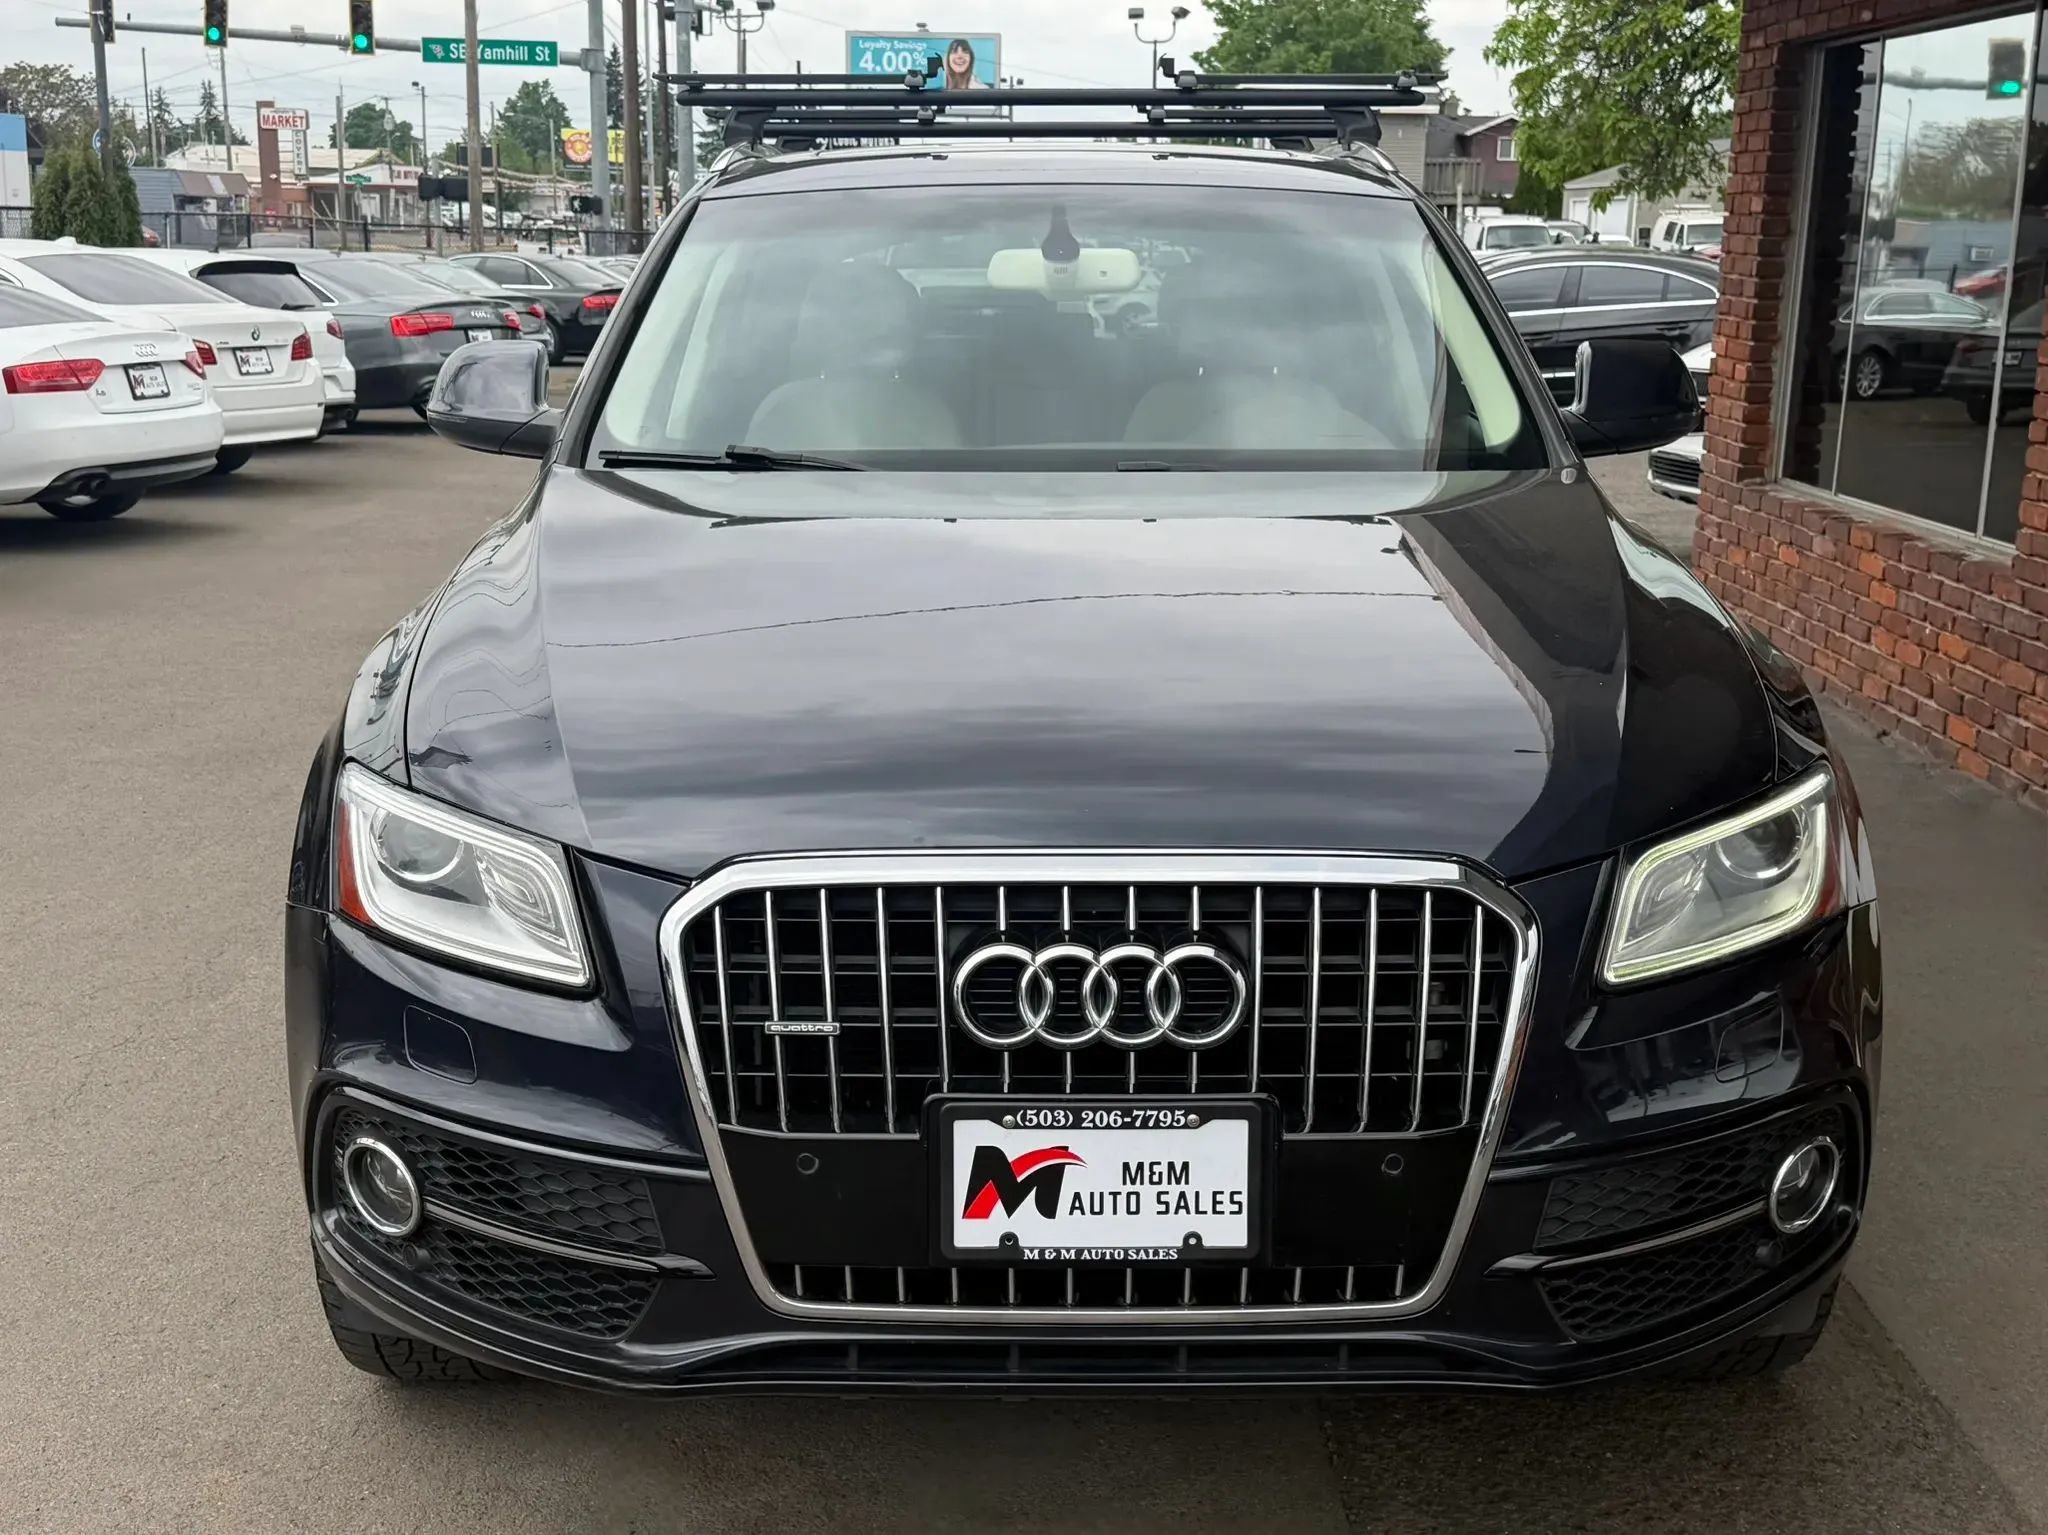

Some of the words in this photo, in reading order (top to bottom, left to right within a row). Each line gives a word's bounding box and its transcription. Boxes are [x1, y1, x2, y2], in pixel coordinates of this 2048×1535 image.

[449, 43, 466, 59] SE
[535, 46, 550, 61] St
[859, 39, 891, 51] Loyalty
[894, 40, 927, 51] Savings
[262, 114, 304, 129] MARKET
[770, 1024, 834, 1032] quattro
[1016, 1109, 1074, 1128] (503)
[1081, 1109, 1186, 1128] 206-7795
[1122, 1161, 1190, 1186] M&M
[1068, 1190, 1141, 1216] AUTO
[1156, 1190, 1243, 1216] SALES
[1023, 1248, 1039, 1260] M
[1044, 1248, 1056, 1260] &
[1060, 1248, 1076, 1260] M
[1080, 1248, 1125, 1260] AUTO
[1128, 1248, 1178, 1260] SALES
